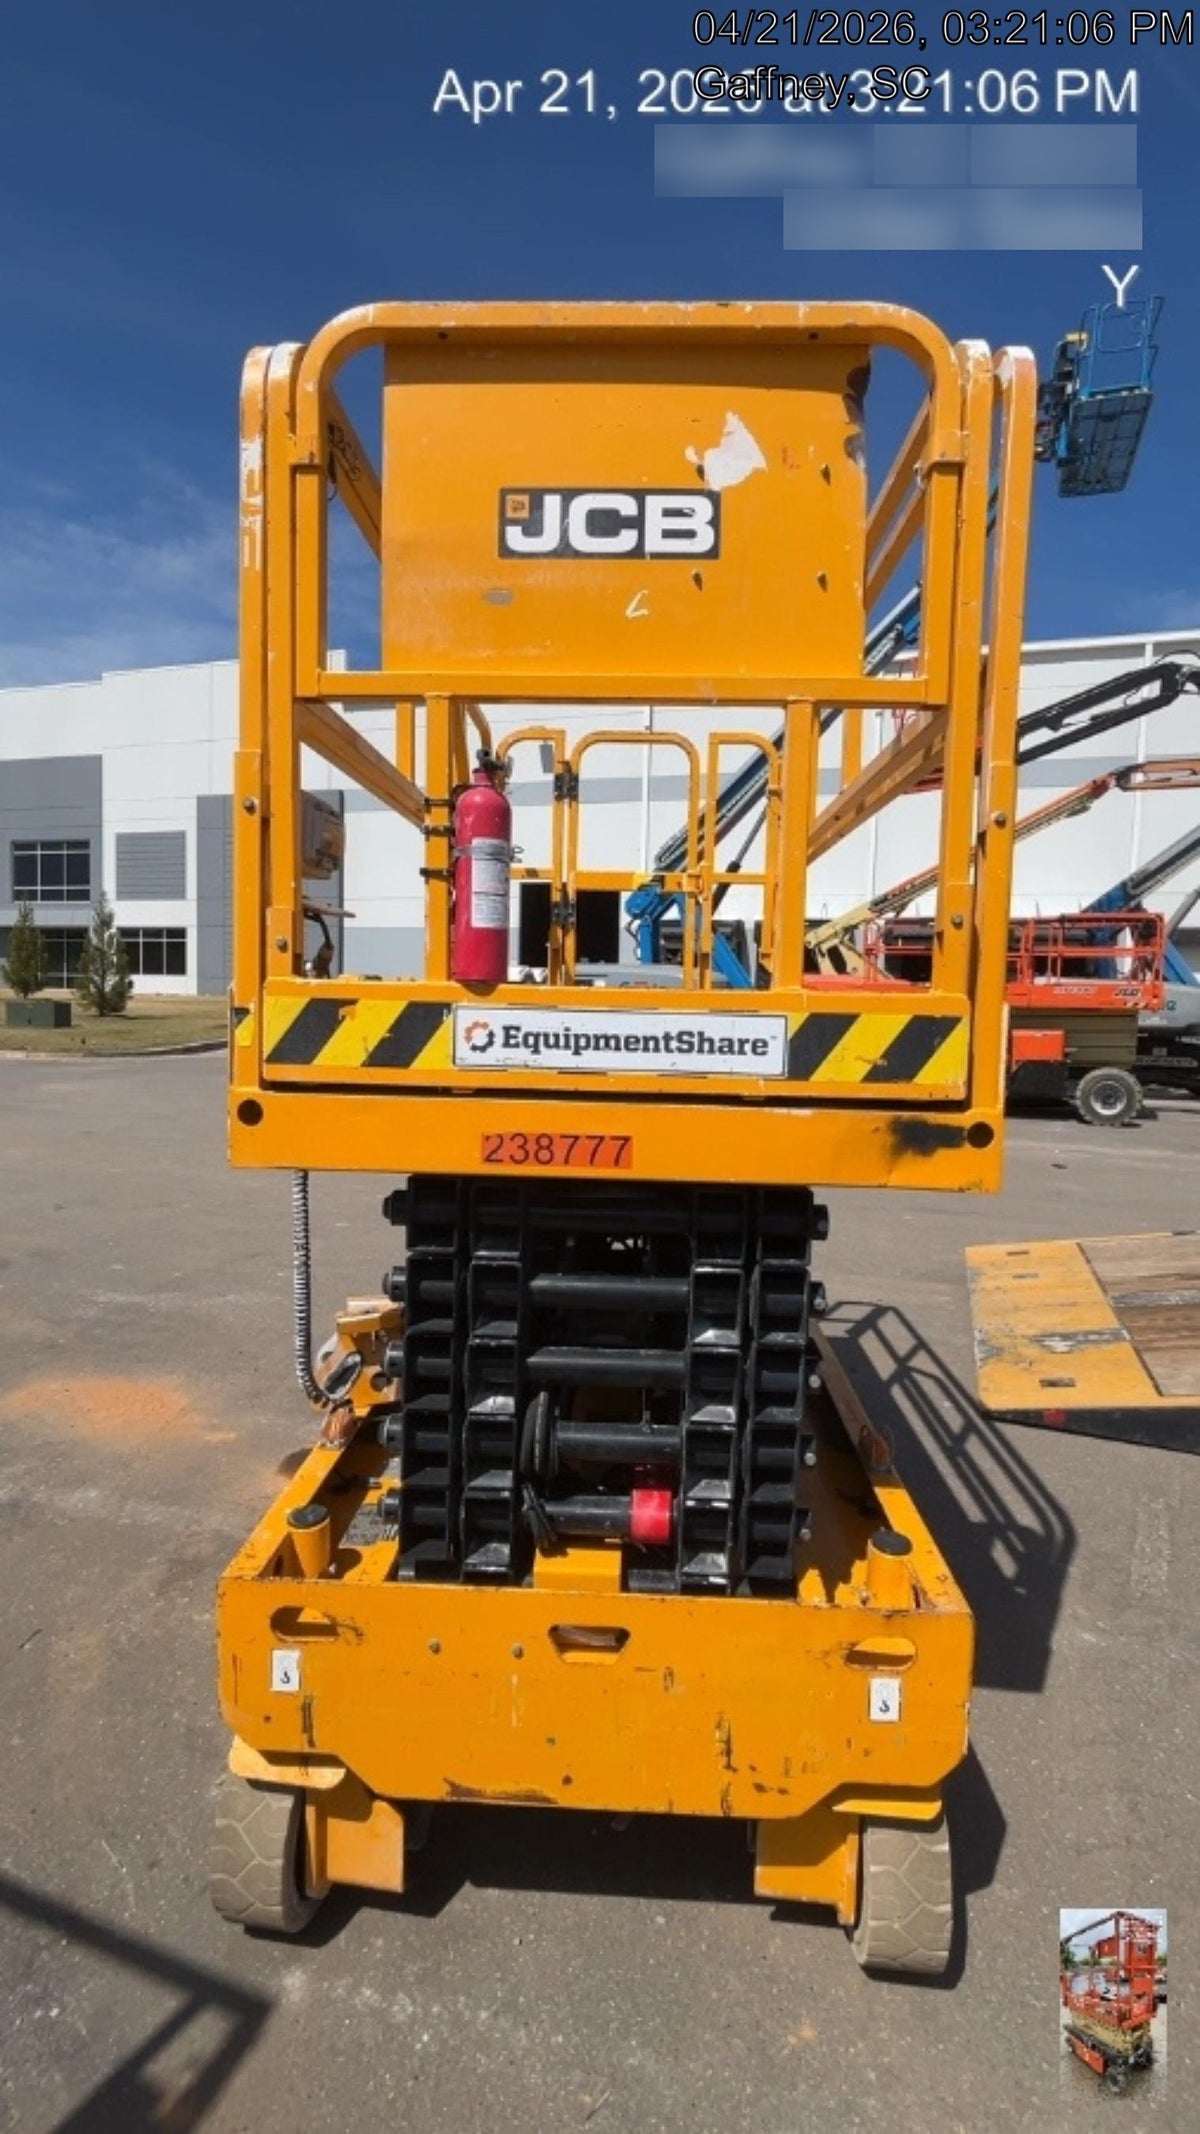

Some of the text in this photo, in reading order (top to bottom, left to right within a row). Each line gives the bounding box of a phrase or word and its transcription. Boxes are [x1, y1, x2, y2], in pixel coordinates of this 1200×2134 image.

[505, 493, 715, 553] JCB
[502, 1025, 769, 1058] EquipmentShare
[484, 1132, 633, 1167] 238777
